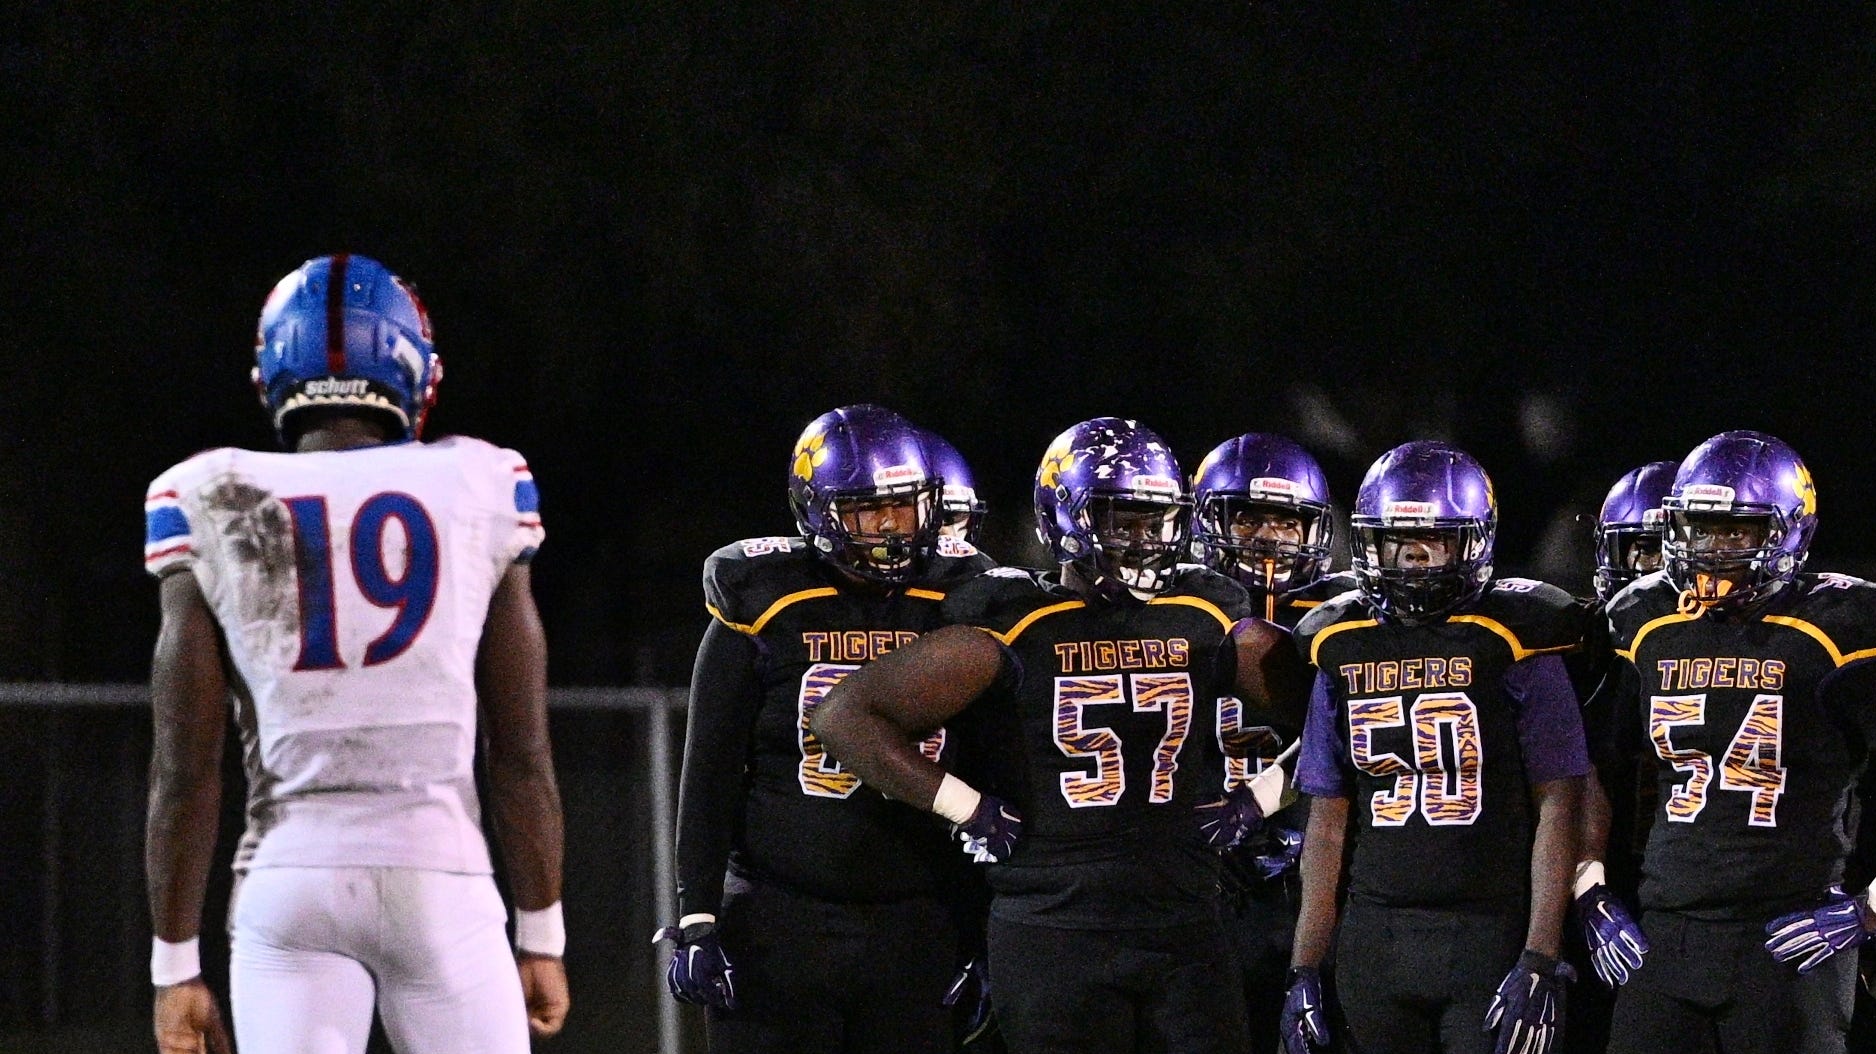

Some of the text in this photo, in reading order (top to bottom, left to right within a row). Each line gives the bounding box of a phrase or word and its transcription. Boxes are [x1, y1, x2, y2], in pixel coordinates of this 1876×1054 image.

[305, 376, 369, 395] schutt
[1144, 478, 1170, 488] Riddell
[1262, 480, 1291, 490] Riddell
[280, 490, 440, 672] 19
[1054, 638, 1190, 672] TIGERS
[1340, 656, 1473, 694] TIGERS
[1657, 657, 1786, 690] TIGERS
[1052, 673, 1194, 809] 57
[1347, 691, 1483, 827] 50
[1650, 693, 1787, 828] 54
